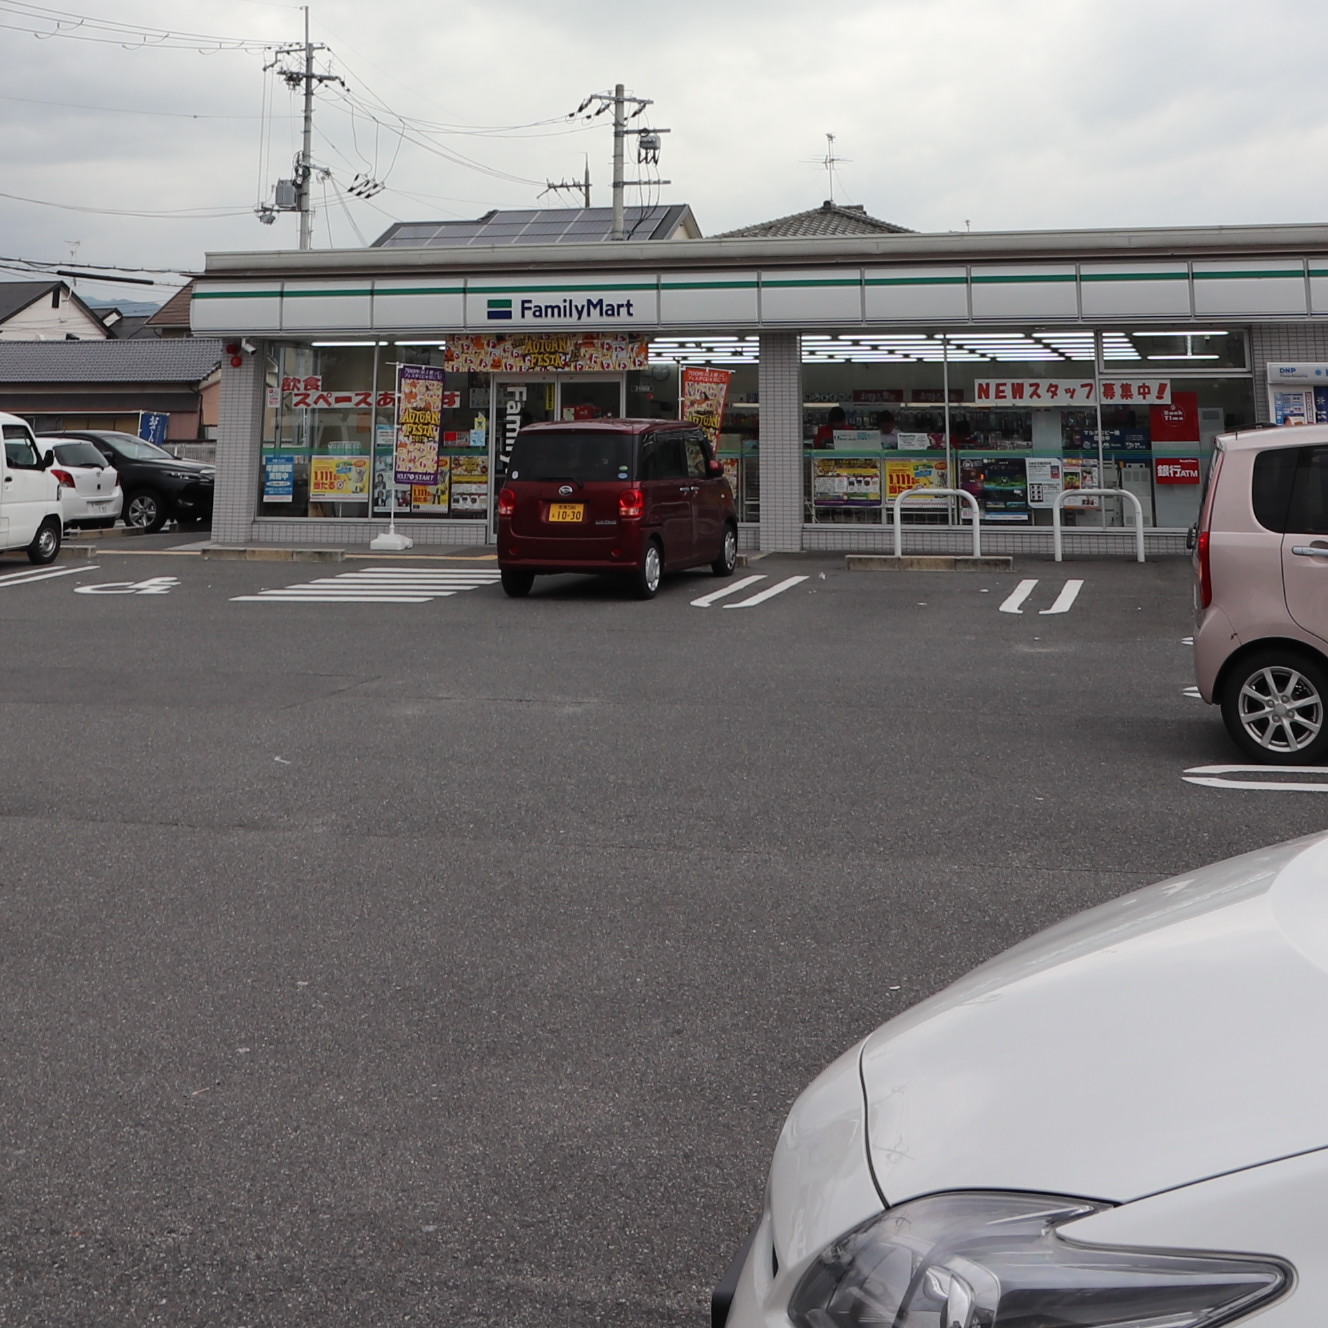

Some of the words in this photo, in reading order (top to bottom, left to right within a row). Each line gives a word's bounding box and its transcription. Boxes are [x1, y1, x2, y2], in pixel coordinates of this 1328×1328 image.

[521, 298, 634, 321] FamilyMart
[530, 353, 565, 369] FESTA
[282, 376, 322, 392] 飲食
[293, 391, 460, 408] スペースあす
[404, 424, 435, 439] FESTA
[1157, 465, 1198, 478] 銀行ATM
[557, 510, 582, 520] 10-30
